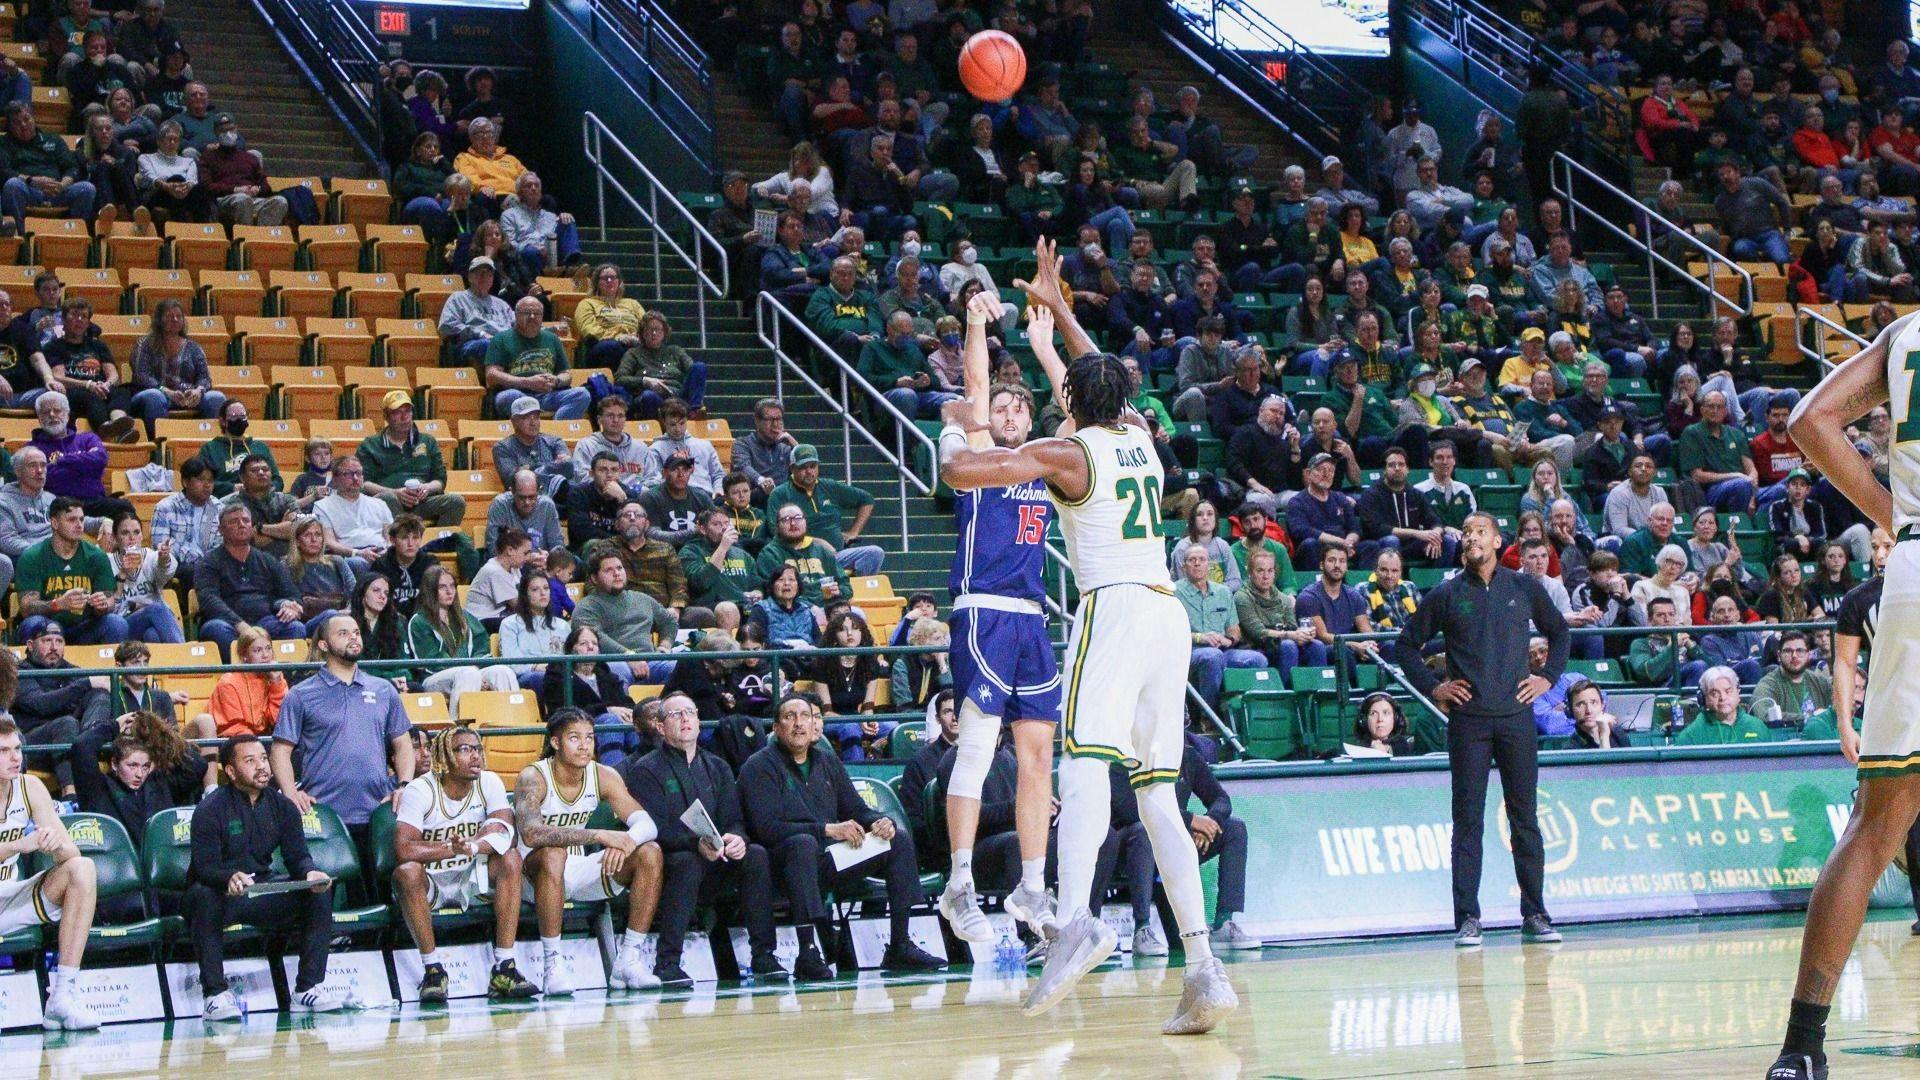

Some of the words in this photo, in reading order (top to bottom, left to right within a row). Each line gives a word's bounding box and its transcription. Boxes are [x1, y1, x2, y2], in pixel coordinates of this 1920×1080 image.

[381, 12, 406, 32] EXIT
[425, 17, 437, 40] 1
[1115, 475, 1164, 539] 20
[1015, 505, 1047, 544] 15
[1590, 790, 1790, 827] CAPITAL
[1317, 826, 1386, 876] LIVE
[1583, 874, 1630, 896] BRIDGE
[1651, 871, 1688, 893] SUITE
[80, 984, 129, 993] SENTARA
